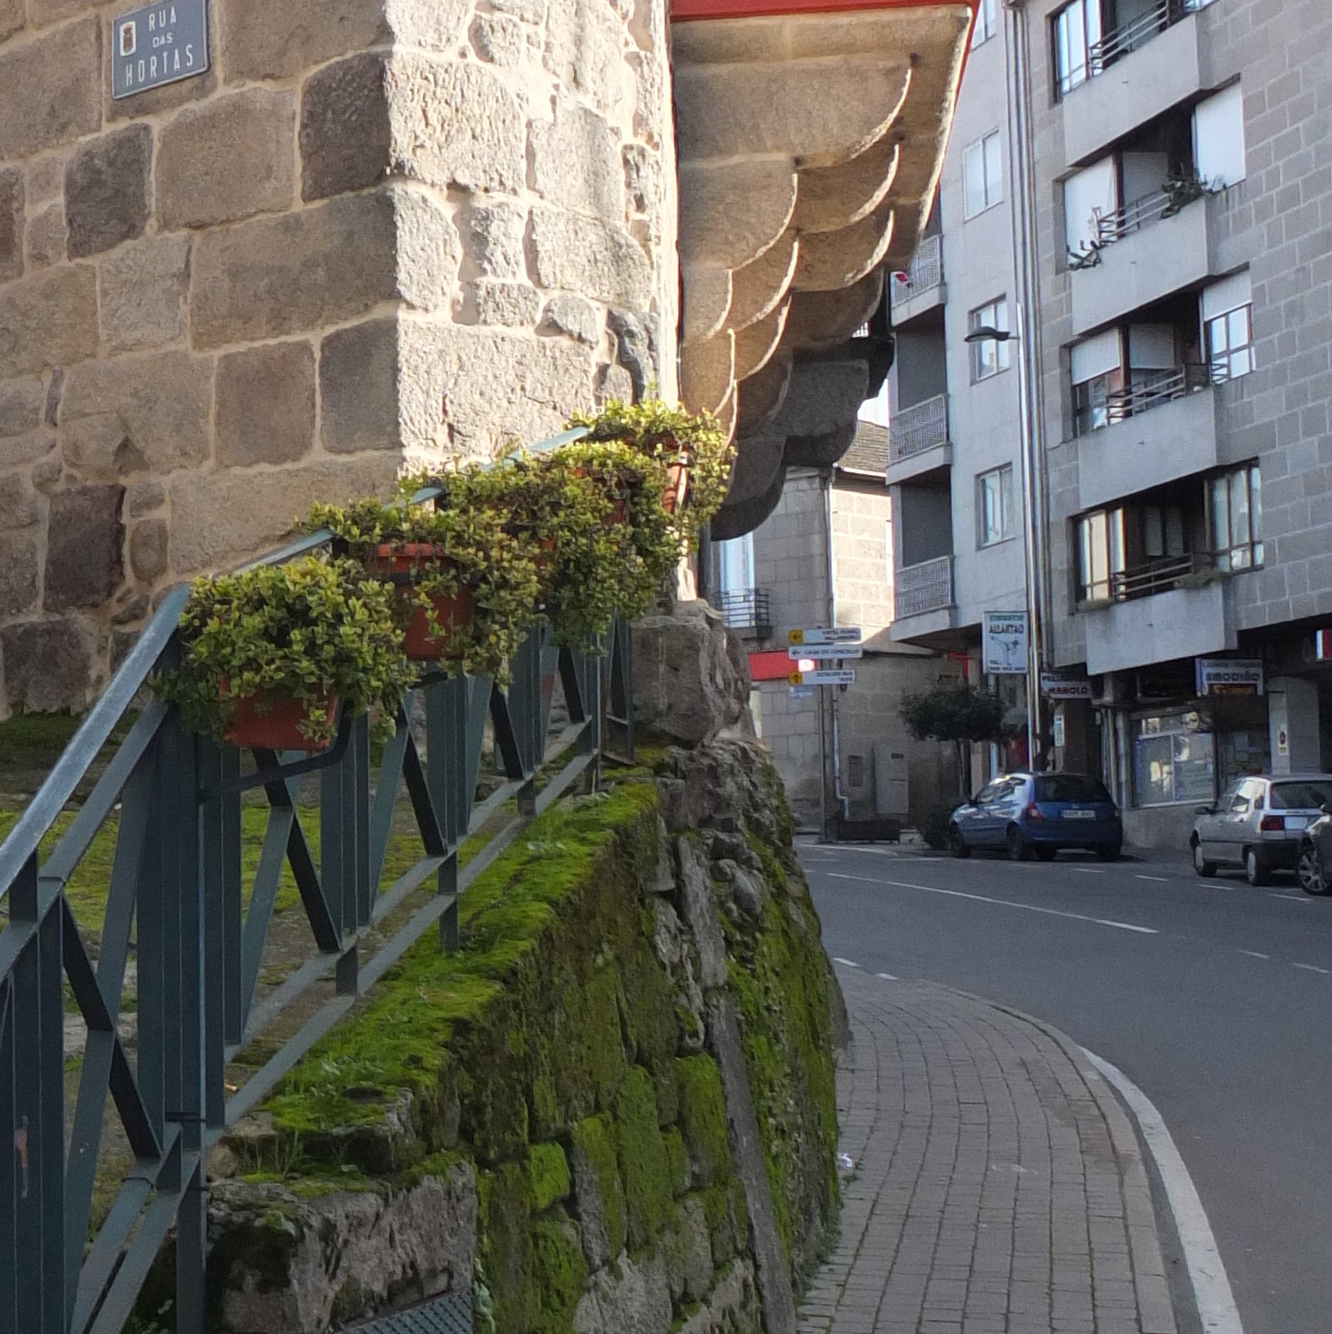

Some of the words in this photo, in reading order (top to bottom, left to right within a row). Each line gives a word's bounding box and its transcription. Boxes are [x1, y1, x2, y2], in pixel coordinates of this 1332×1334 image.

[149, 6, 176, 31] RUA
[152, 32, 173, 48] DAS
[125, 44, 193, 86] HORTAS
